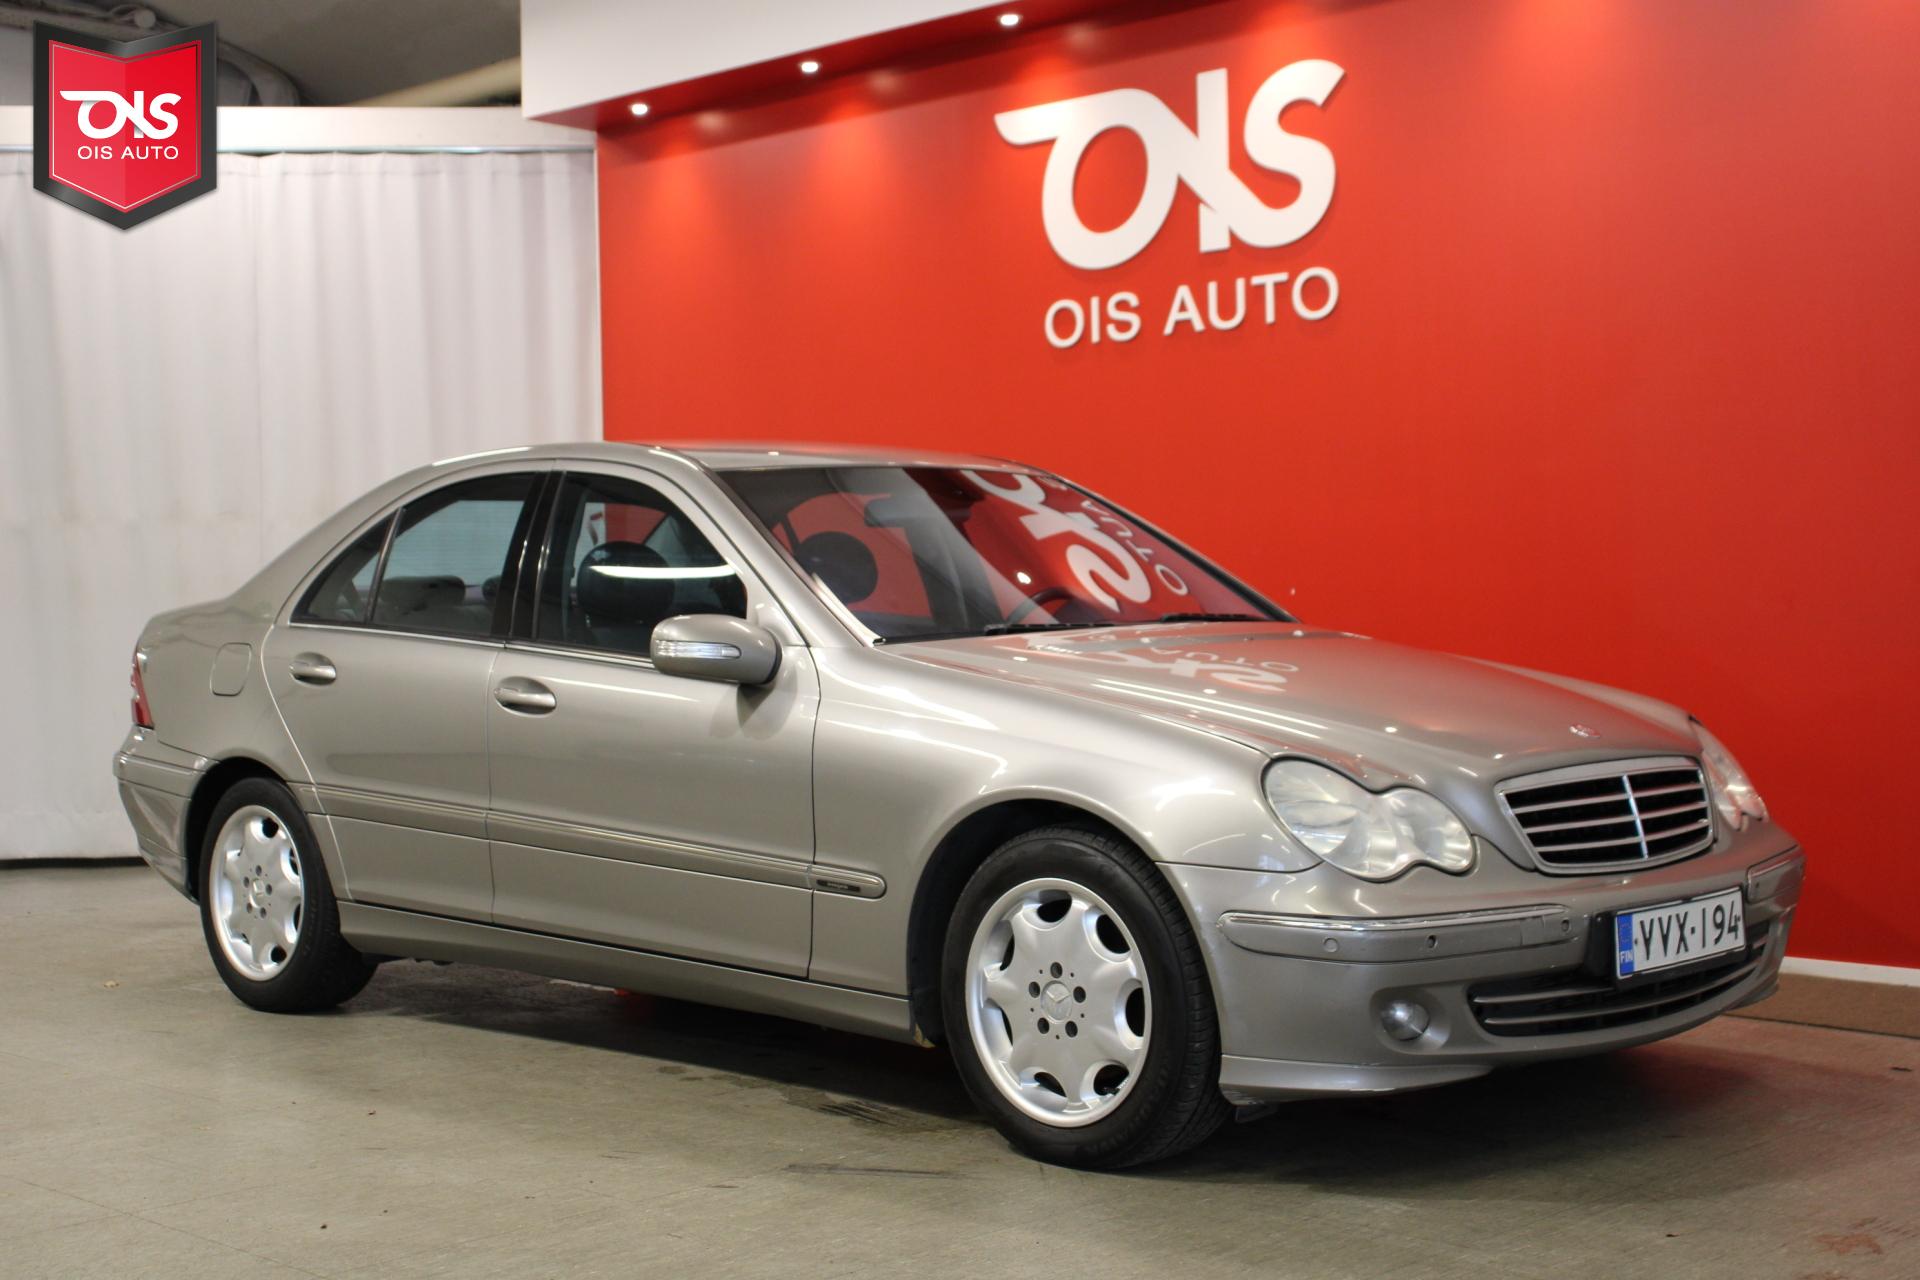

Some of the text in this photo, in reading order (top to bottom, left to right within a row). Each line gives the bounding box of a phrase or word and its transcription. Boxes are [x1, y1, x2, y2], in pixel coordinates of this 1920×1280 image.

[1044, 266, 1339, 348] OIS AUTO
[1620, 950, 1634, 964] FIN
